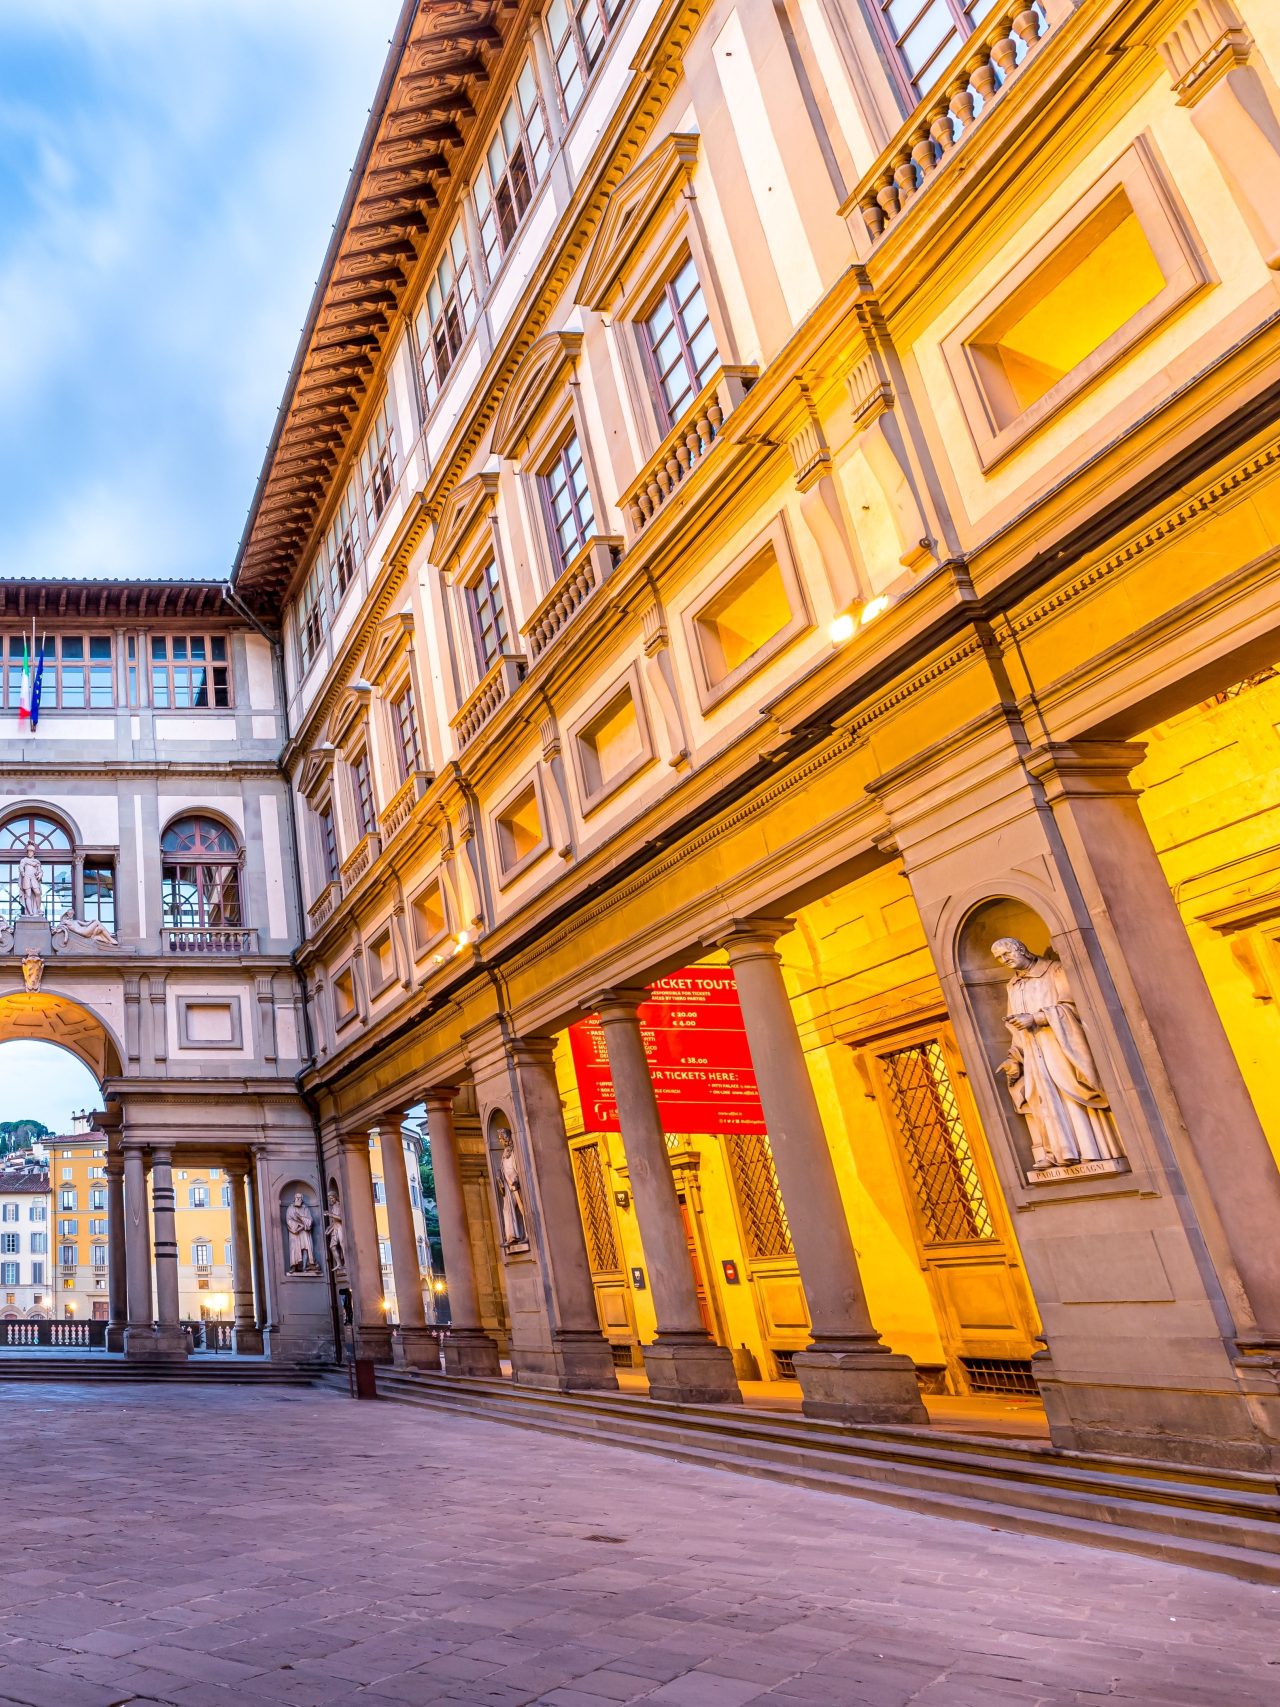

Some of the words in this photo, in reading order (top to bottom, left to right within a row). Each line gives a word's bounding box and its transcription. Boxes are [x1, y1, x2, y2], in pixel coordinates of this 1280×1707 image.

[695, 979, 737, 990] TOUTS
[665, 1071, 706, 1080] TICKETS
[708, 1073, 739, 1081] HERE:
[1036, 1170, 1061, 1180] PAOLO
[1063, 1163, 1105, 1175] MASCAGNI
